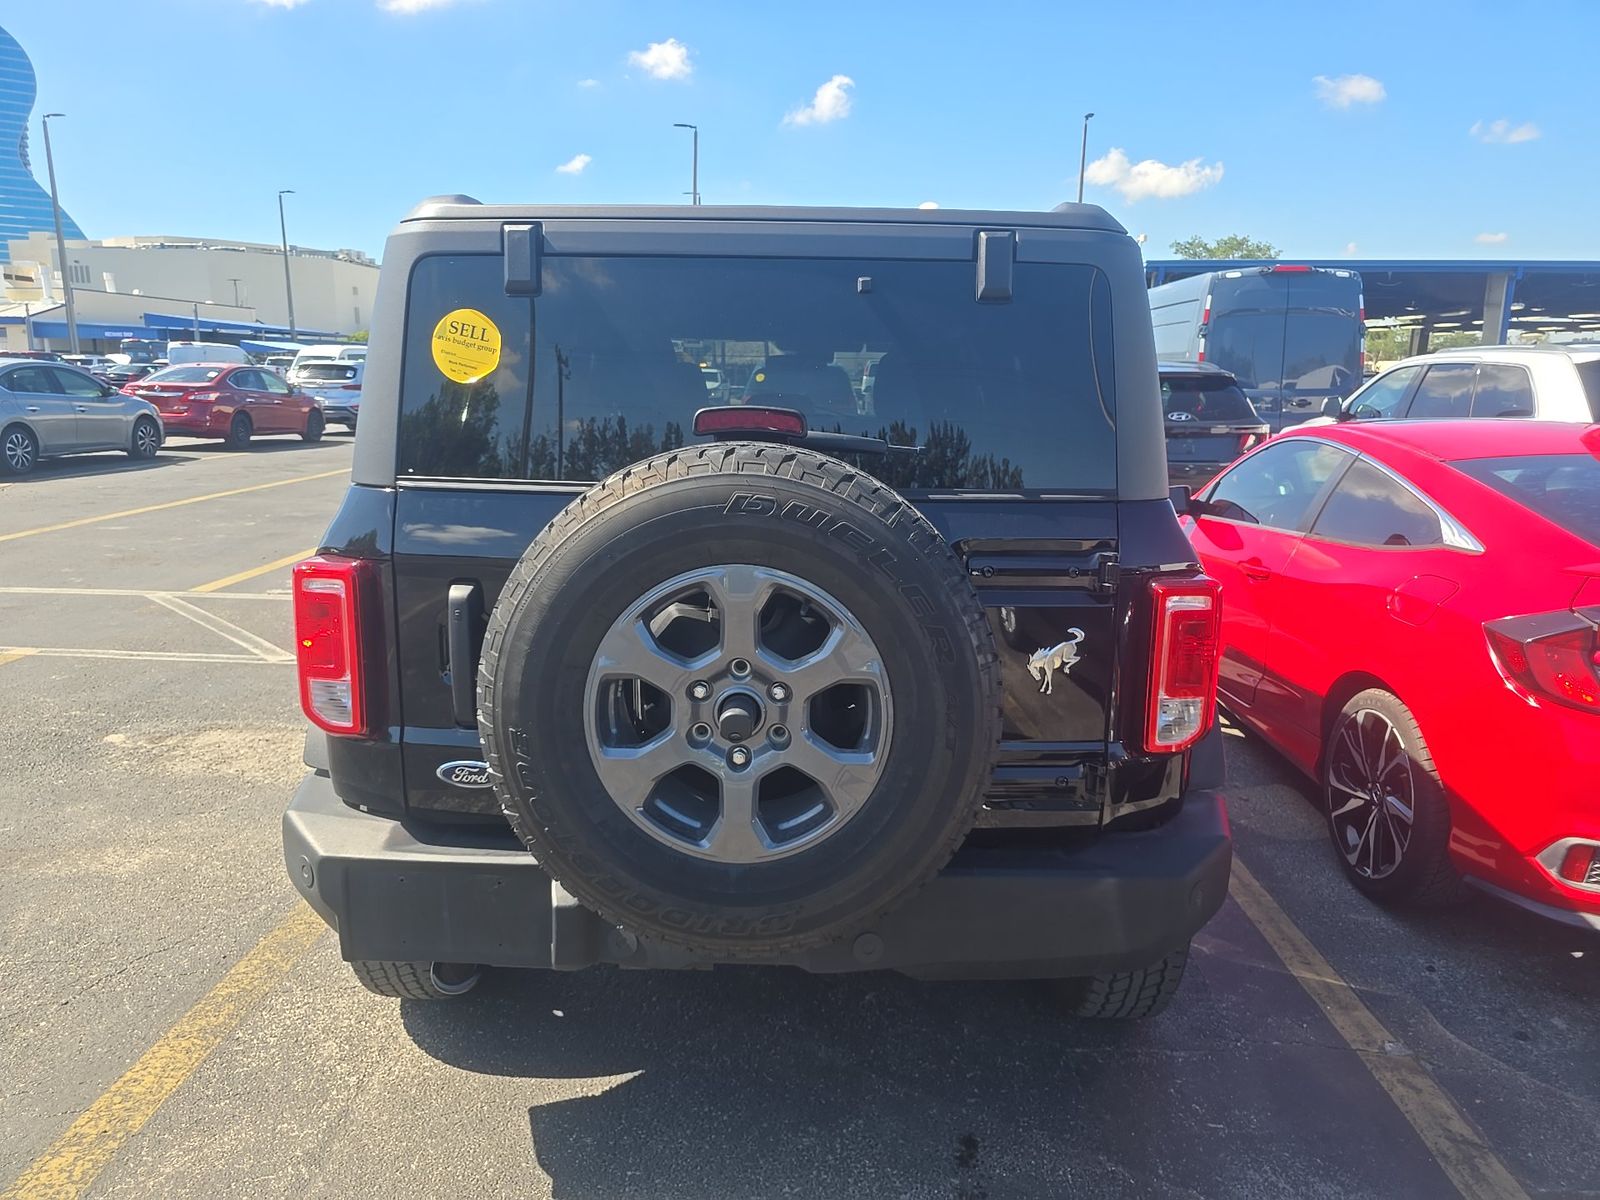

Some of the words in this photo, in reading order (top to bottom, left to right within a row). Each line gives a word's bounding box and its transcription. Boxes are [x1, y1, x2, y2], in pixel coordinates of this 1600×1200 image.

[449, 321, 490, 342] SELL
[452, 337, 476, 349] budget
[477, 343, 497, 355] group
[723, 491, 957, 665] DUELER
[452, 766, 489, 783] Ford
